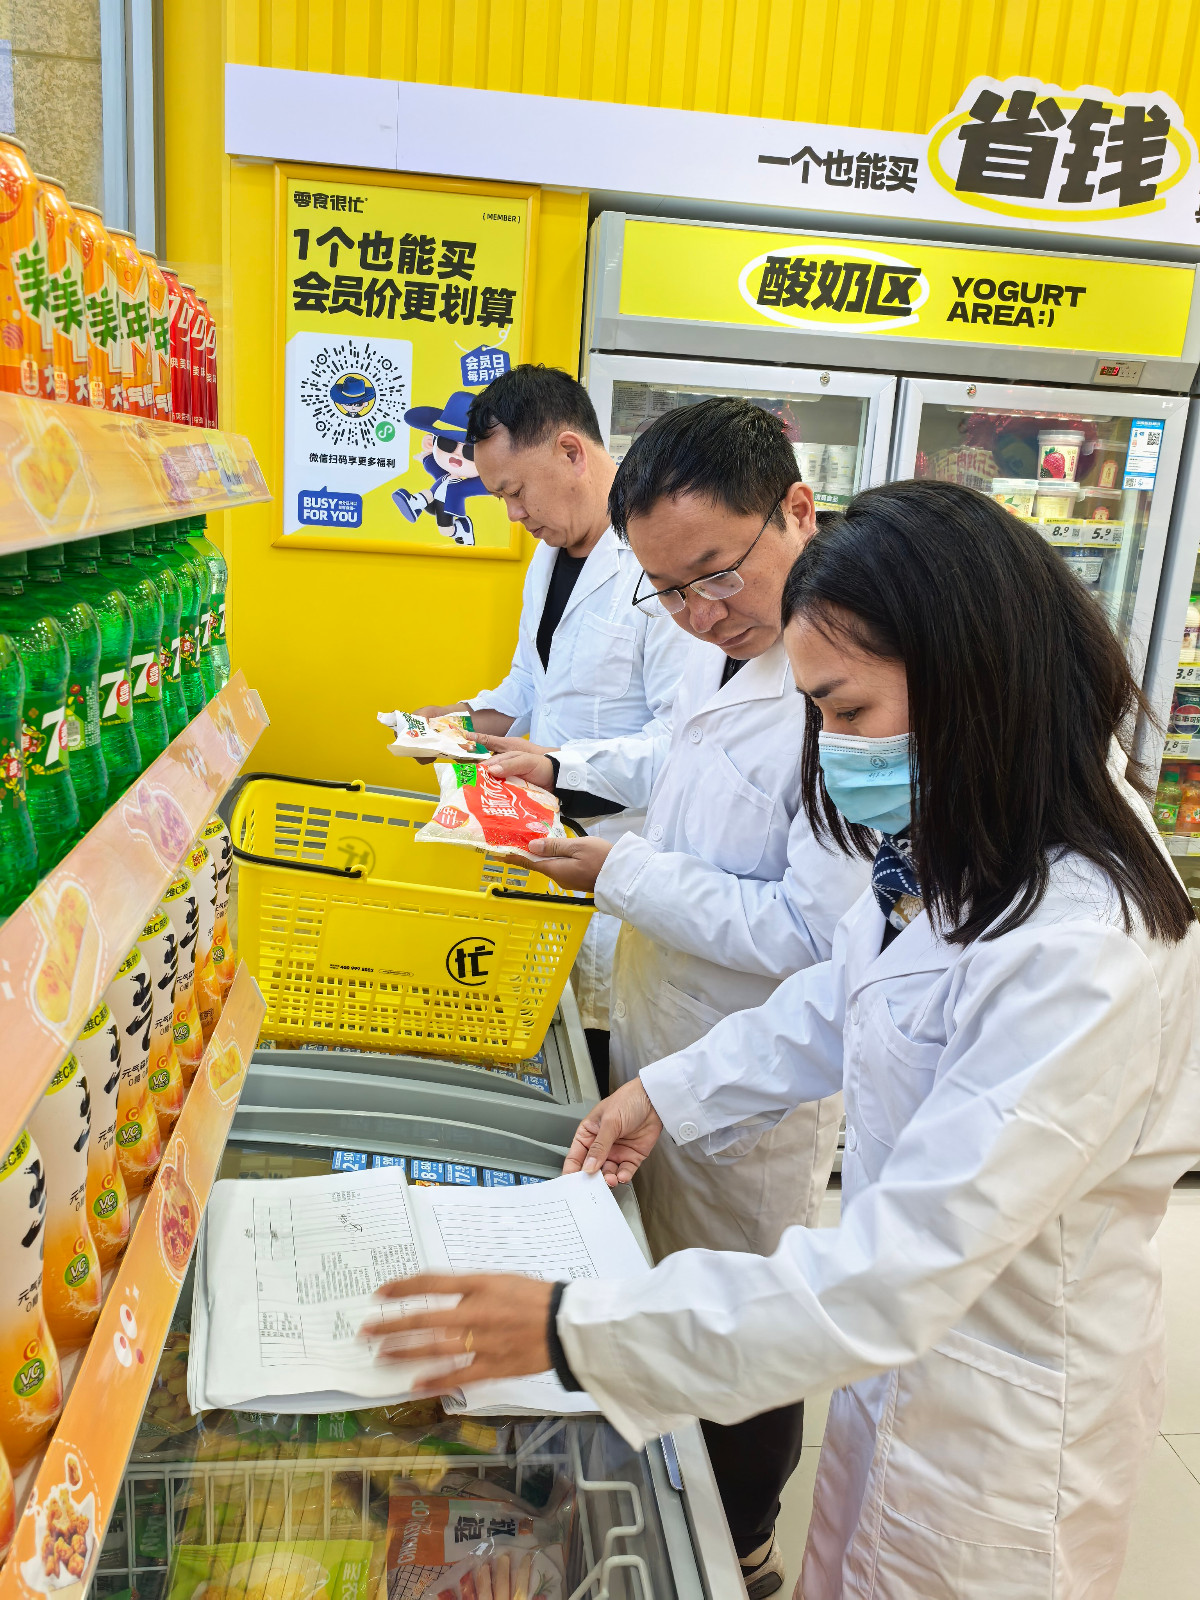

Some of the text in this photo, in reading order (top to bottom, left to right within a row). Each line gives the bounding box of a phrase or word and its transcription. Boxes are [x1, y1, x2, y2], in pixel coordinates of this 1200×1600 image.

[757, 89, 1171, 208] 一个也能买 省钱
[293, 190, 366, 213] 零食很忙
[293, 226, 478, 282] 1个也能买
[756, 255, 922, 317] 酸奶区
[951, 276, 1087, 308] YOGURT
[293, 271, 517, 329] 会员价更划算
[465, 354, 505, 370] 会员日
[309, 452, 396, 468] 微信扫码享更多福利
[303, 496, 338, 509] BUSY
[303, 508, 358, 523] FOR YOU
[1091, 527, 1112, 540] 5.9
